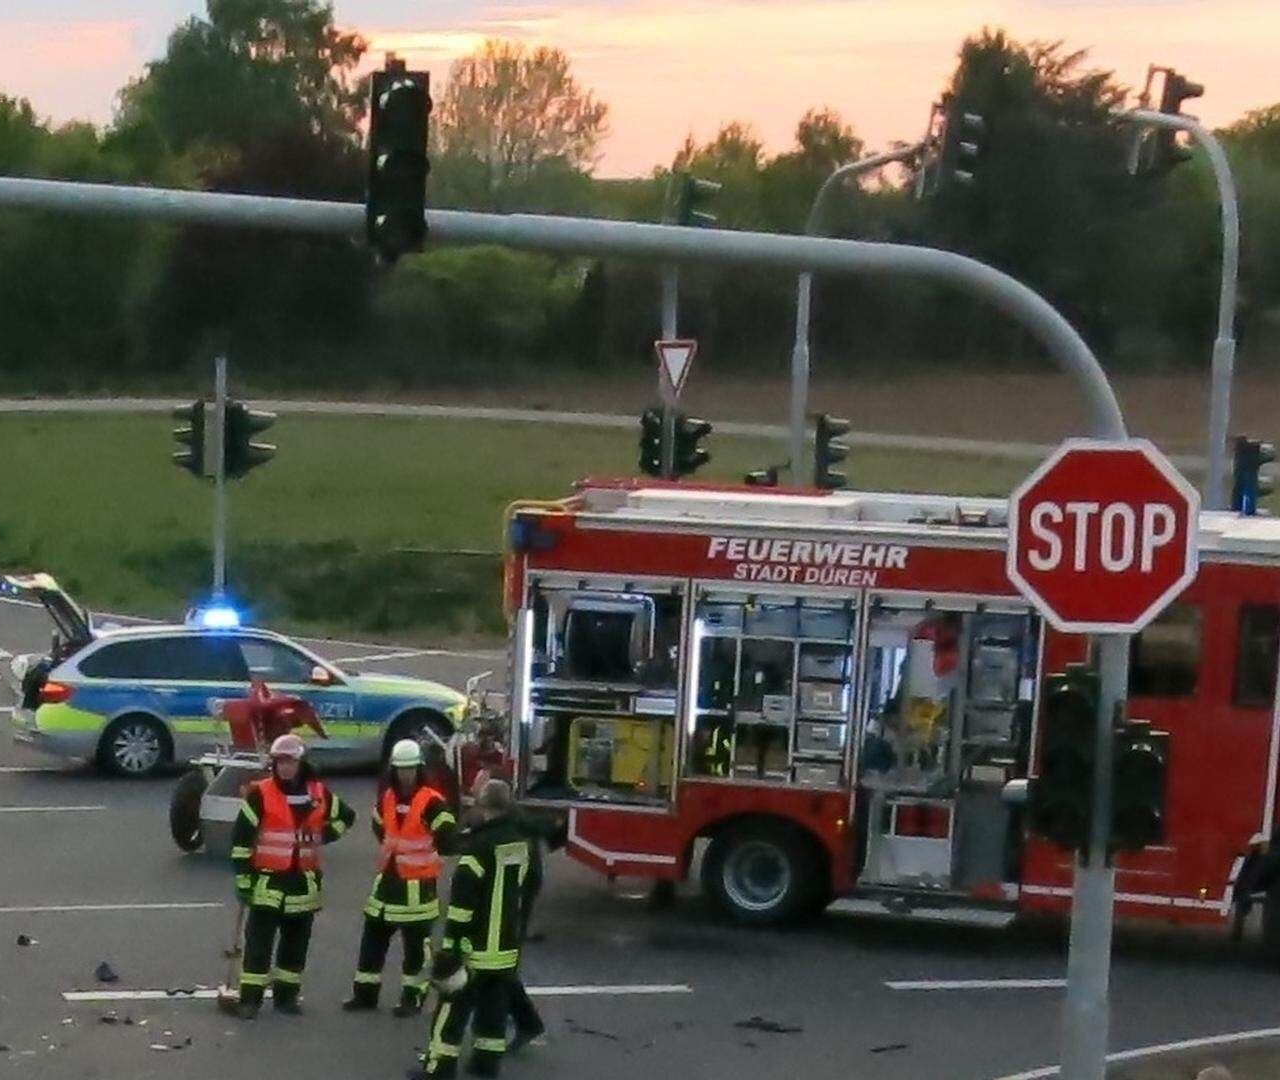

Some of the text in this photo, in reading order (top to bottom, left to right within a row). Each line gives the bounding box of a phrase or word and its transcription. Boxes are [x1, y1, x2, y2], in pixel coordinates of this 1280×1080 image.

[706, 536, 910, 569] FEUERWEHR
[1027, 501, 1177, 572] STOP
[733, 562, 879, 588] STADT DÜREN
